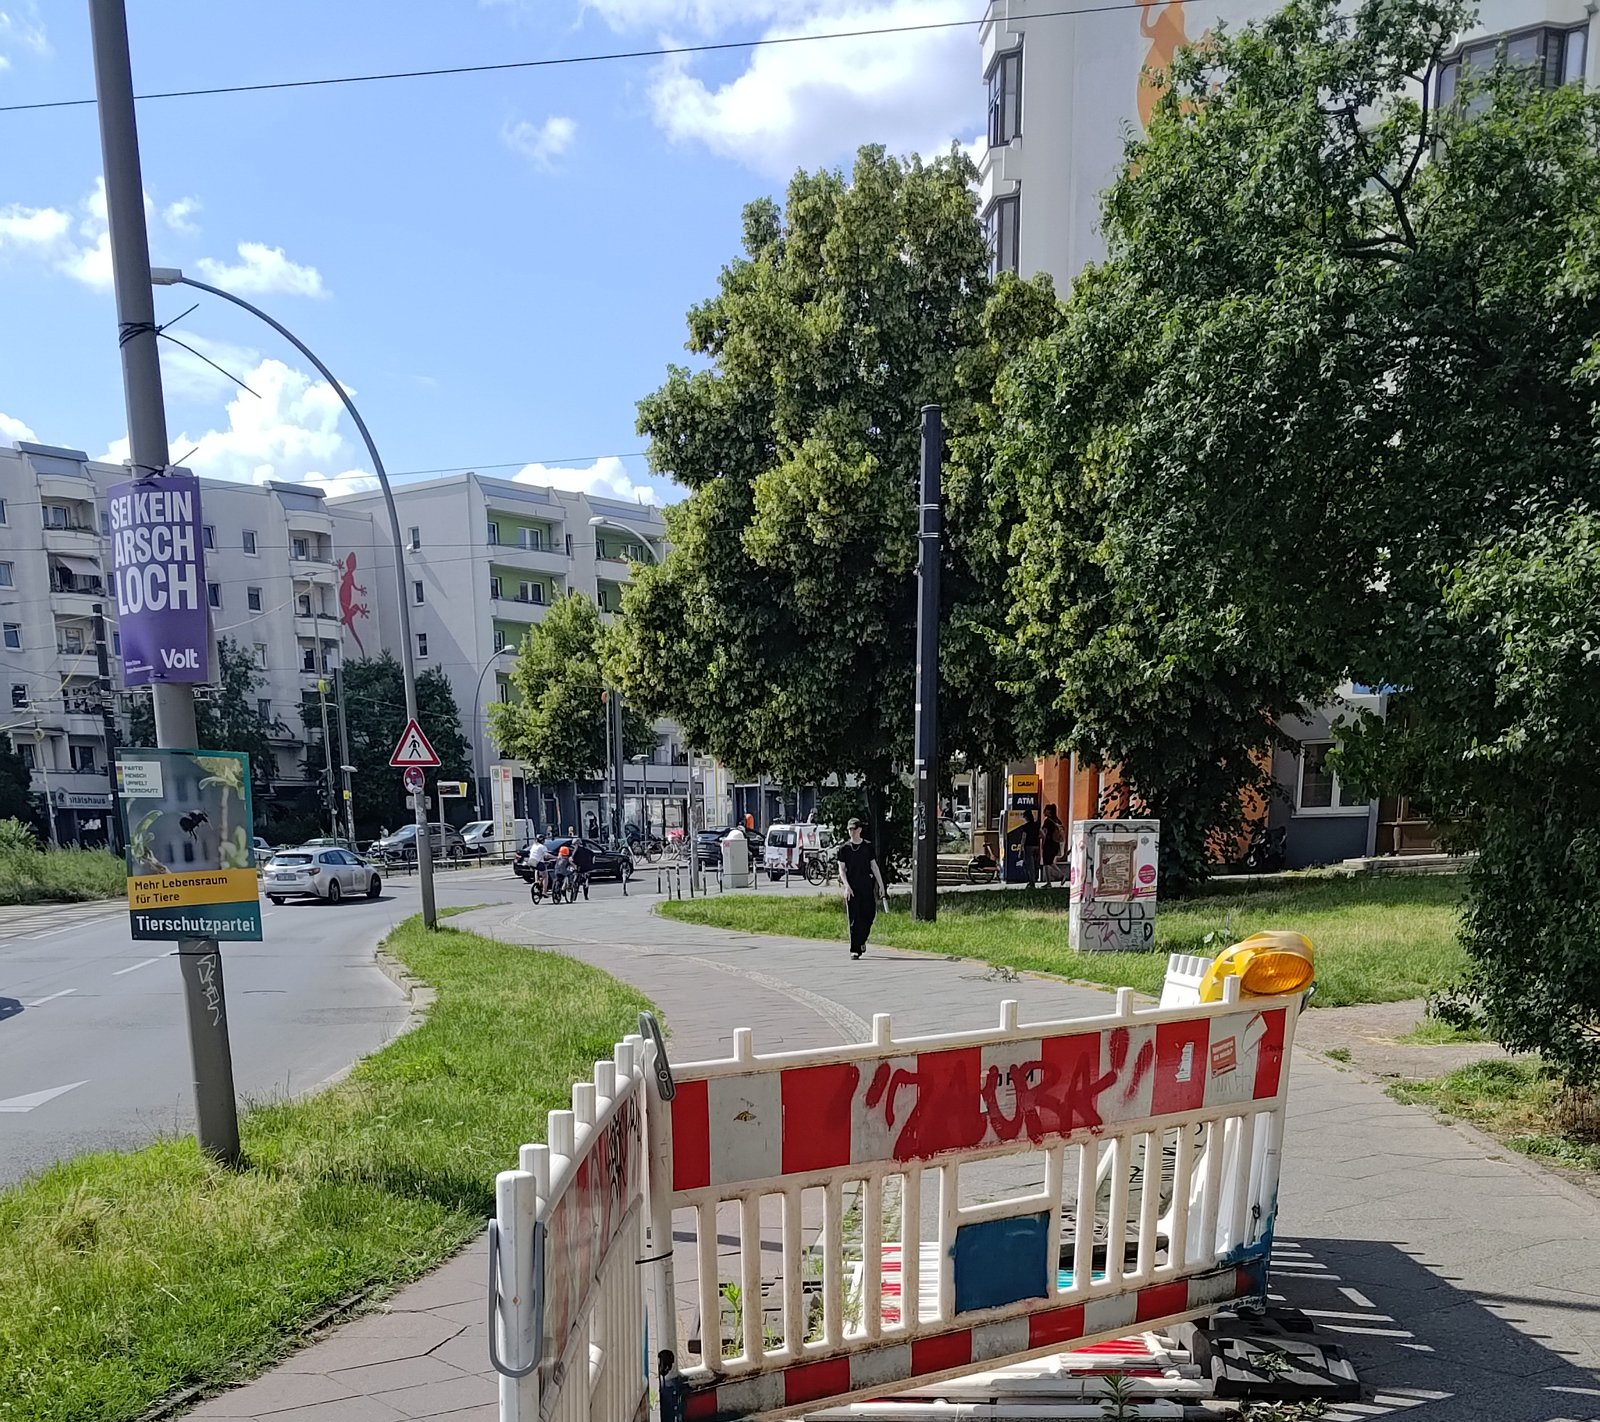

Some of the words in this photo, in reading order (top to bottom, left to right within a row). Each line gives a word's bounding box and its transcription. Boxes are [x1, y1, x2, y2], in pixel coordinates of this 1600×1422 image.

[110, 495, 132, 530] SEI
[135, 491, 193, 524] KEIN
[115, 525, 196, 569] ARSCH
[116, 563, 198, 616] LOCH
[160, 648, 199, 669] Volt
[1017, 797, 1034, 805] ATM
[135, 880, 159, 891] Mehr
[162, 876, 228, 889] Lebensraum
[136, 893, 151, 904] für
[153, 893, 180, 903] Tiere
[136, 916, 255, 935] Tierschutzpartei
